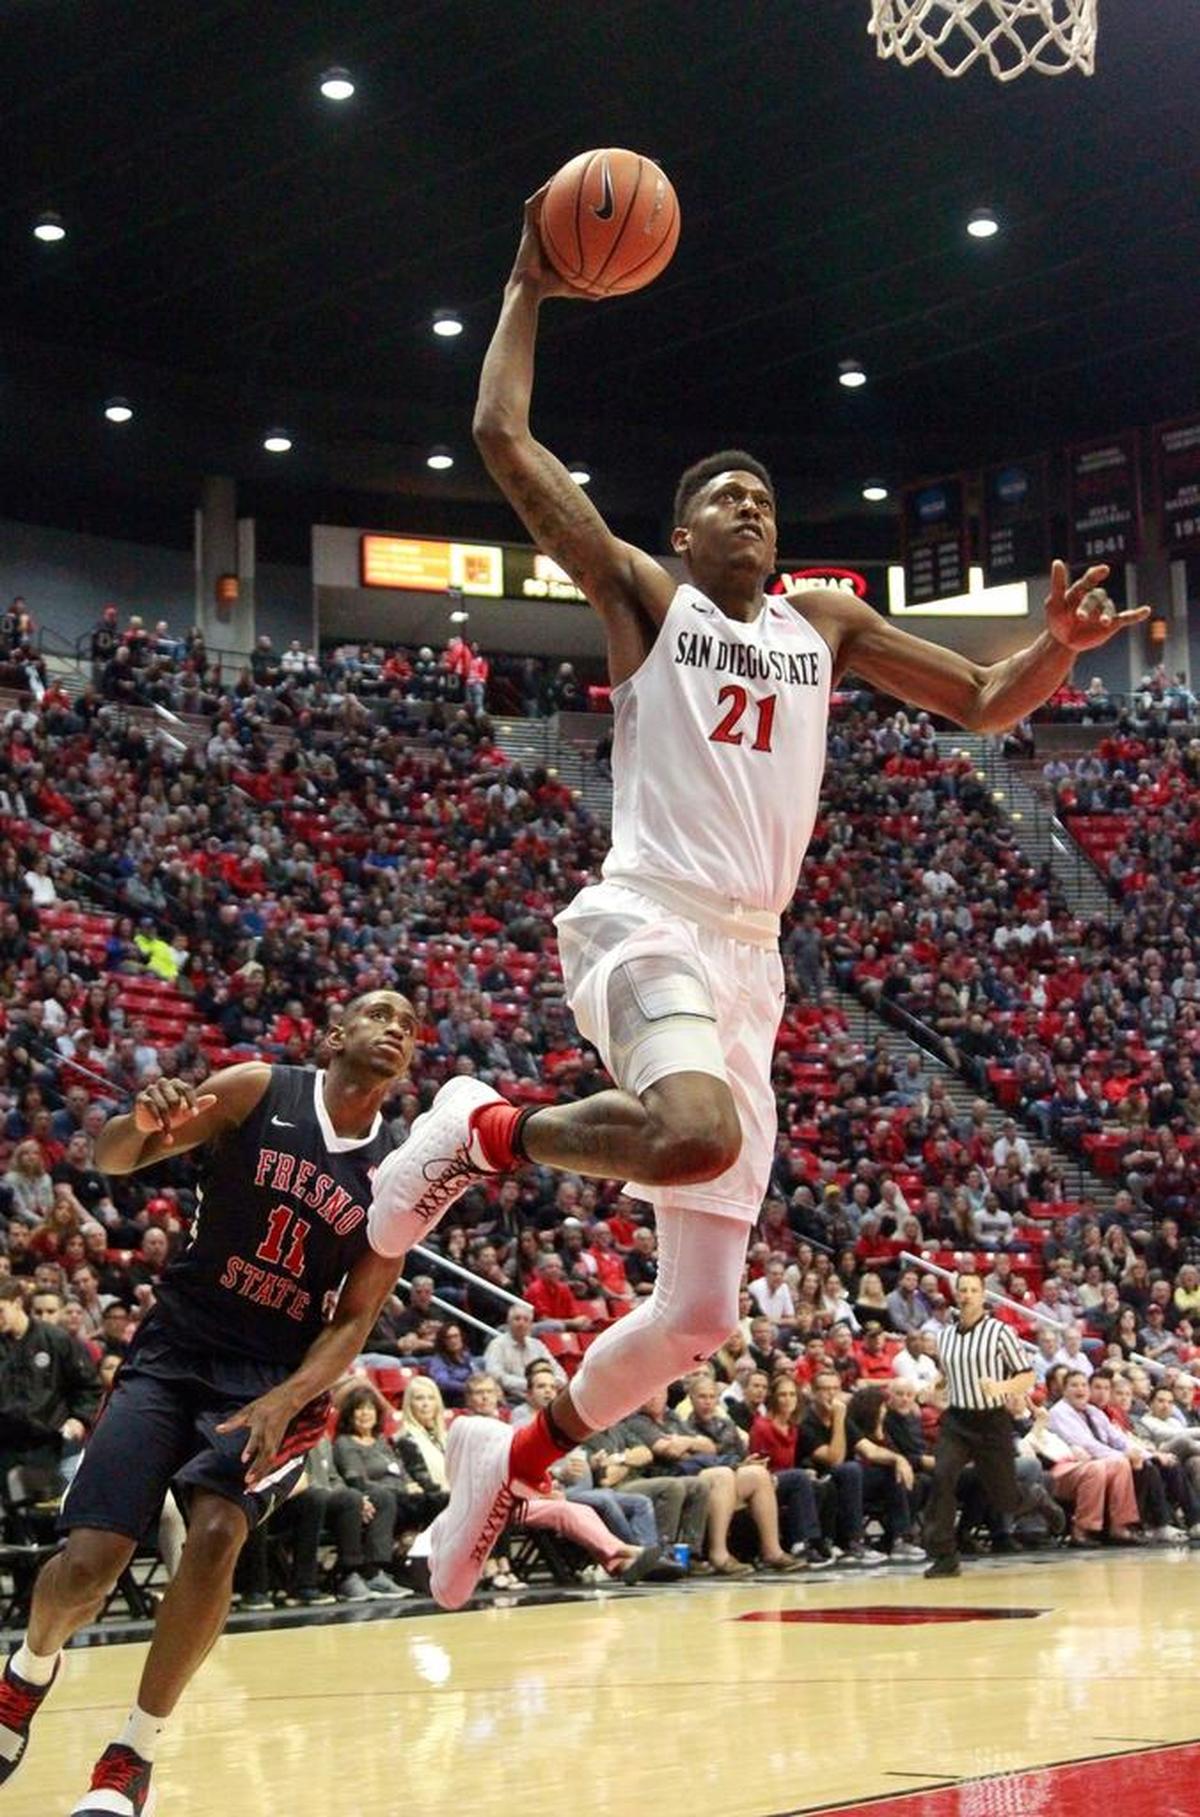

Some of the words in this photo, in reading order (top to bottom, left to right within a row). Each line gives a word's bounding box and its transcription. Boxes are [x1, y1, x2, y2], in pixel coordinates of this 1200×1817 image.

[1085, 534, 1124, 556] 1941
[675, 631, 713, 668] SAN
[715, 640, 770, 680] DIEGO
[769, 651, 819, 686] STATE
[709, 684, 777, 753] 21
[255, 1148, 365, 1235] FRESNO
[256, 1204, 310, 1278] 11
[220, 1256, 310, 1321] STATE
